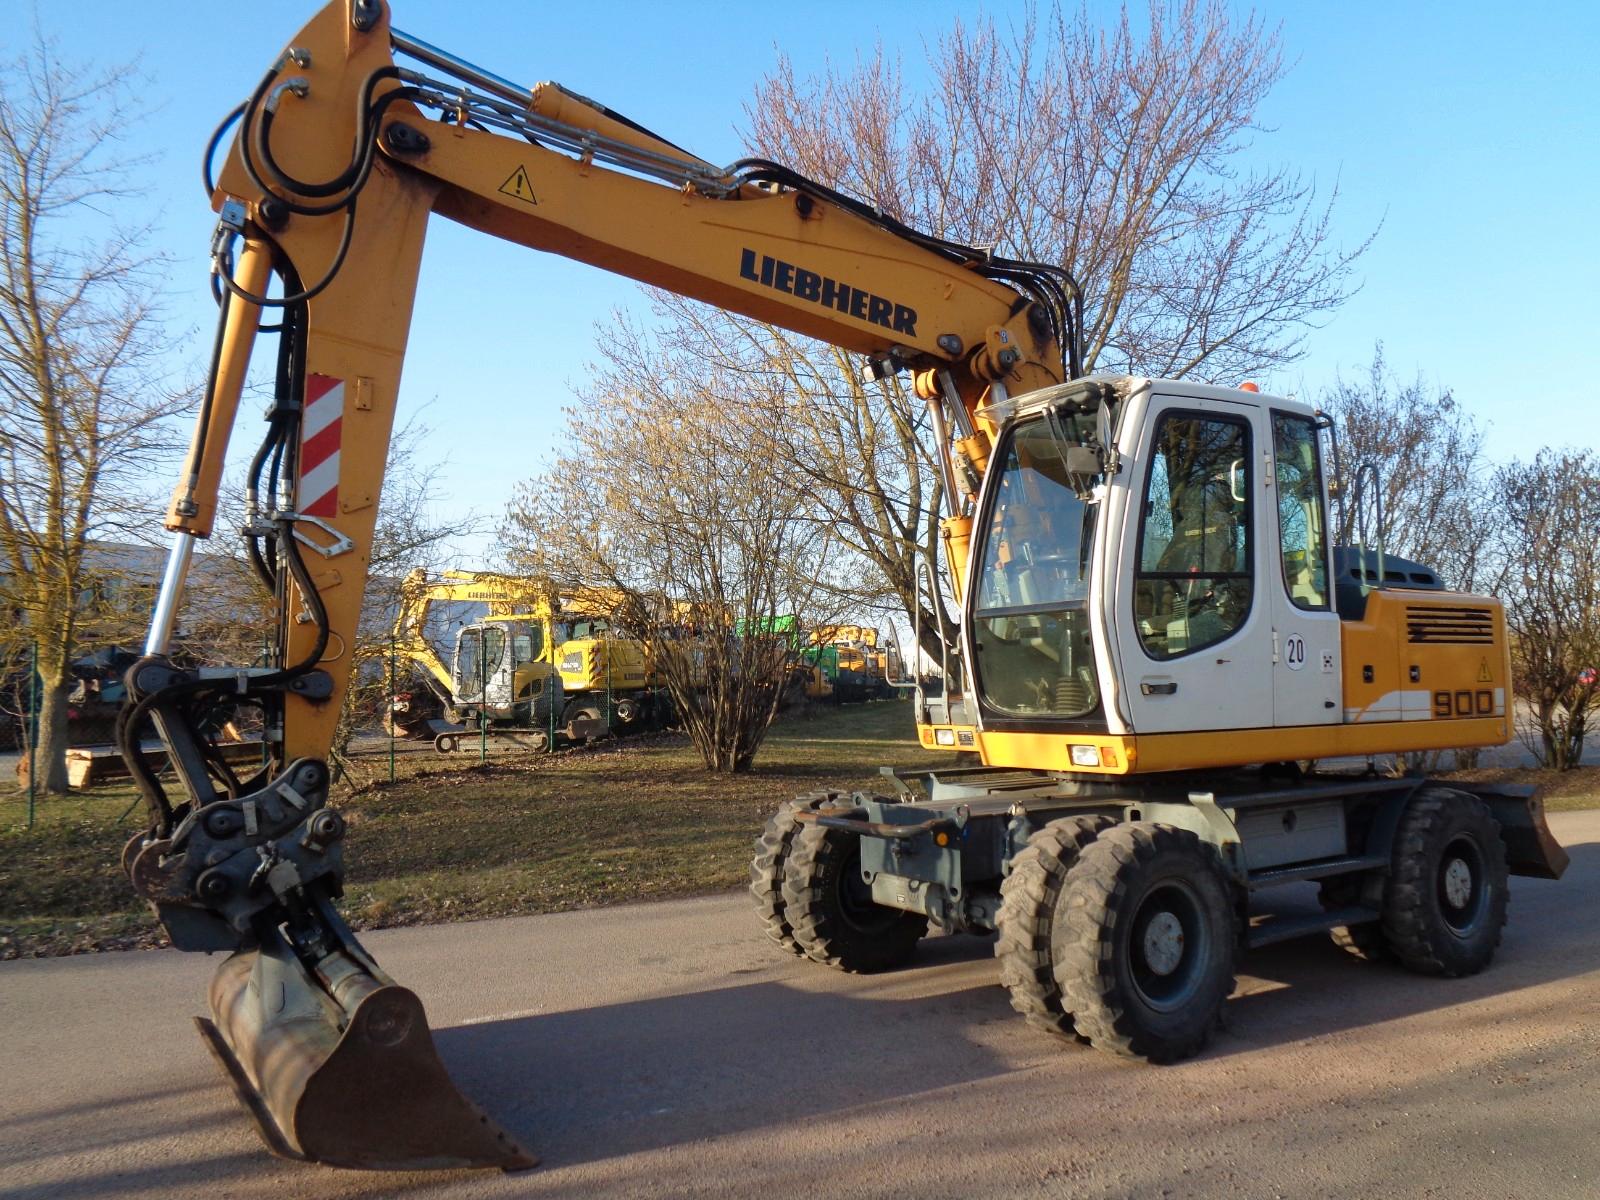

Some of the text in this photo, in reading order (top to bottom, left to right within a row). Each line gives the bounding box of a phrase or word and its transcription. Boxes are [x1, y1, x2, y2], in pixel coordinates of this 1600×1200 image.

[740, 248, 918, 337] LIEBHERR
[1287, 639, 1304, 664] 20
[1434, 691, 1493, 717] 900
